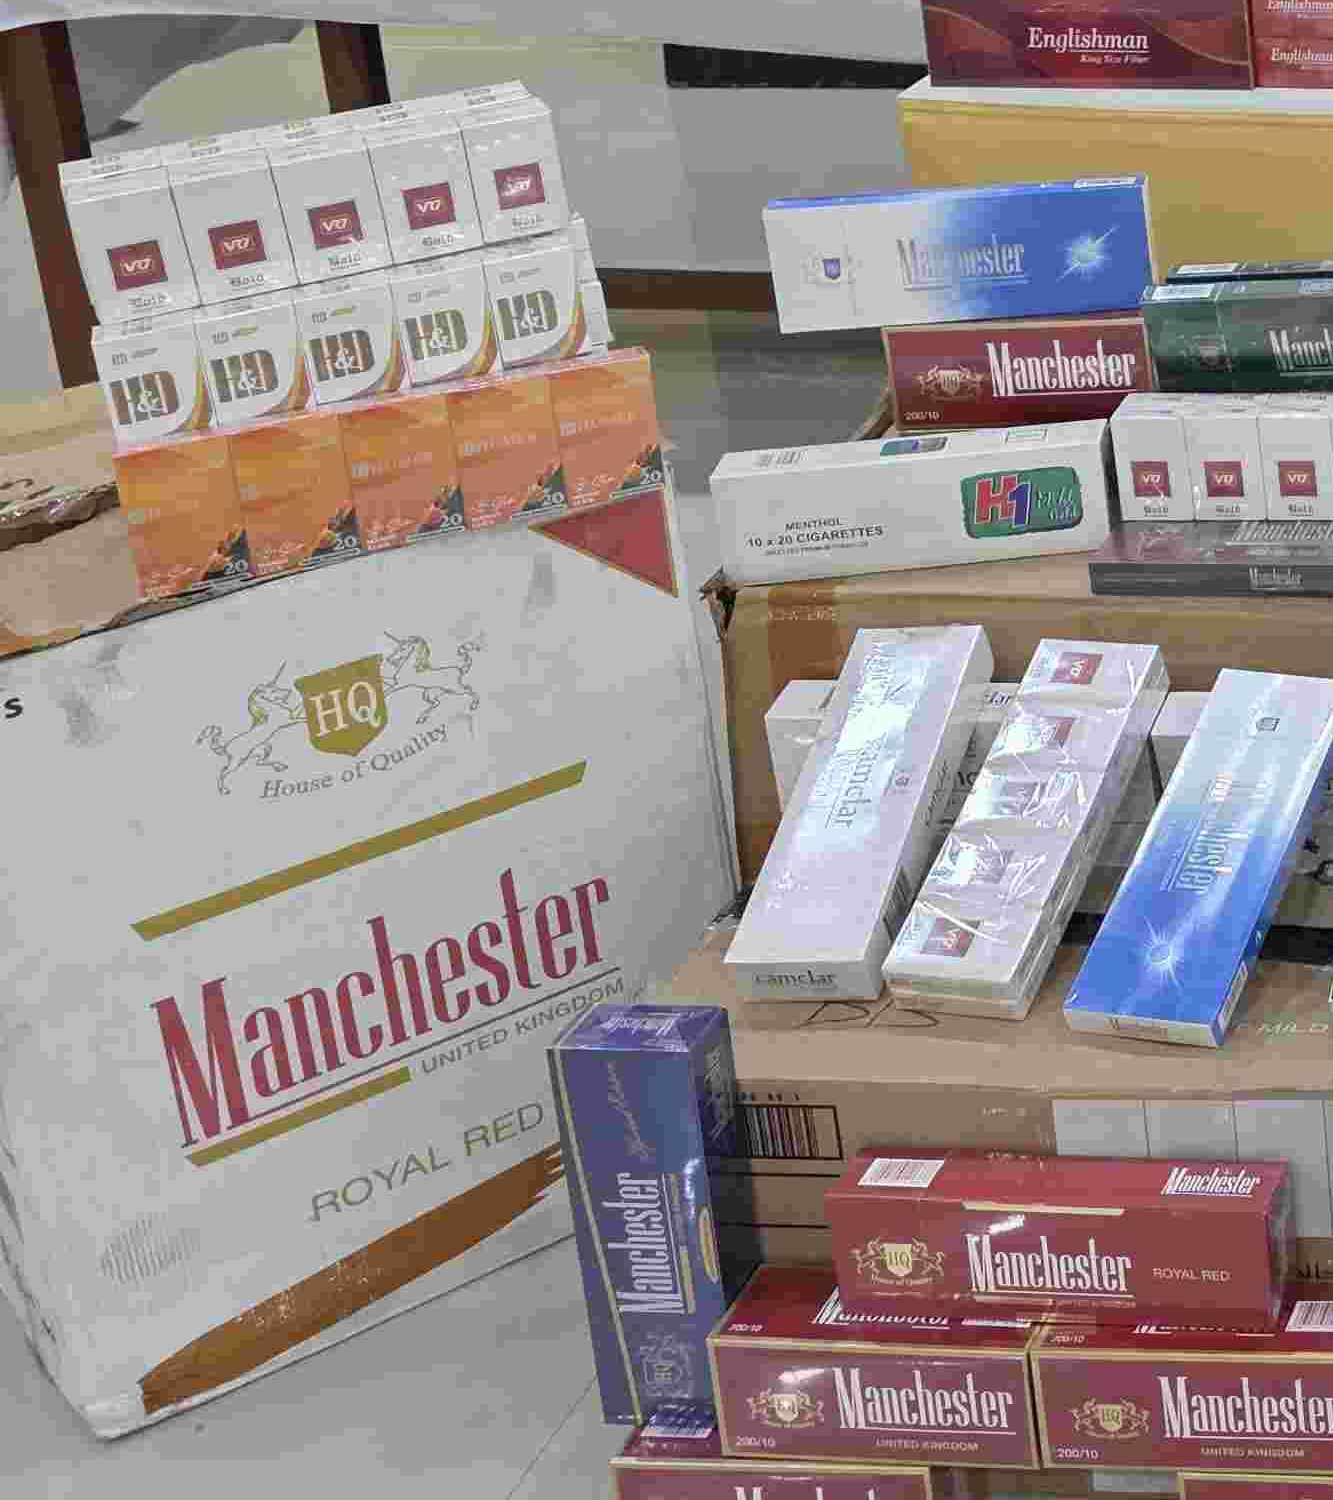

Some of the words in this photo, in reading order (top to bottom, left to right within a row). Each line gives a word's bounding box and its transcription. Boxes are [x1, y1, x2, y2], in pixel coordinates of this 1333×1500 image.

[1027, 26, 1150, 53] Englishman
[748, 536, 762, 548] 10
[776, 535, 794, 547] 20
[796, 526, 883, 543] CIGARETTES
[785, 517, 841, 532] MENTHOL
[311, 680, 382, 738] HQ
[260, 771, 334, 800] House
[340, 759, 369, 784] of
[370, 721, 451, 774] Quality
[148, 867, 612, 1149] Manchester
[420, 1027, 511, 1076] UNITED
[514, 977, 627, 1036] KINGDOM
[308, 1144, 455, 1223] ROYAL
[463, 1101, 546, 1158] RED
[1161, 1166, 1261, 1197] Manchester
[602, 1171, 686, 1315] Manchester
[887, 1253, 911, 1269] HQ
[1152, 1266, 1198, 1281] ROYAL
[1200, 1268, 1231, 1282] RED
[832, 1366, 1014, 1431] Manchester
[735, 1435, 776, 1448] 200/10
[876, 1438, 918, 1451] UNITED
[921, 1439, 979, 1452] KINGDOM
[1055, 1446, 1099, 1460] 200/10
